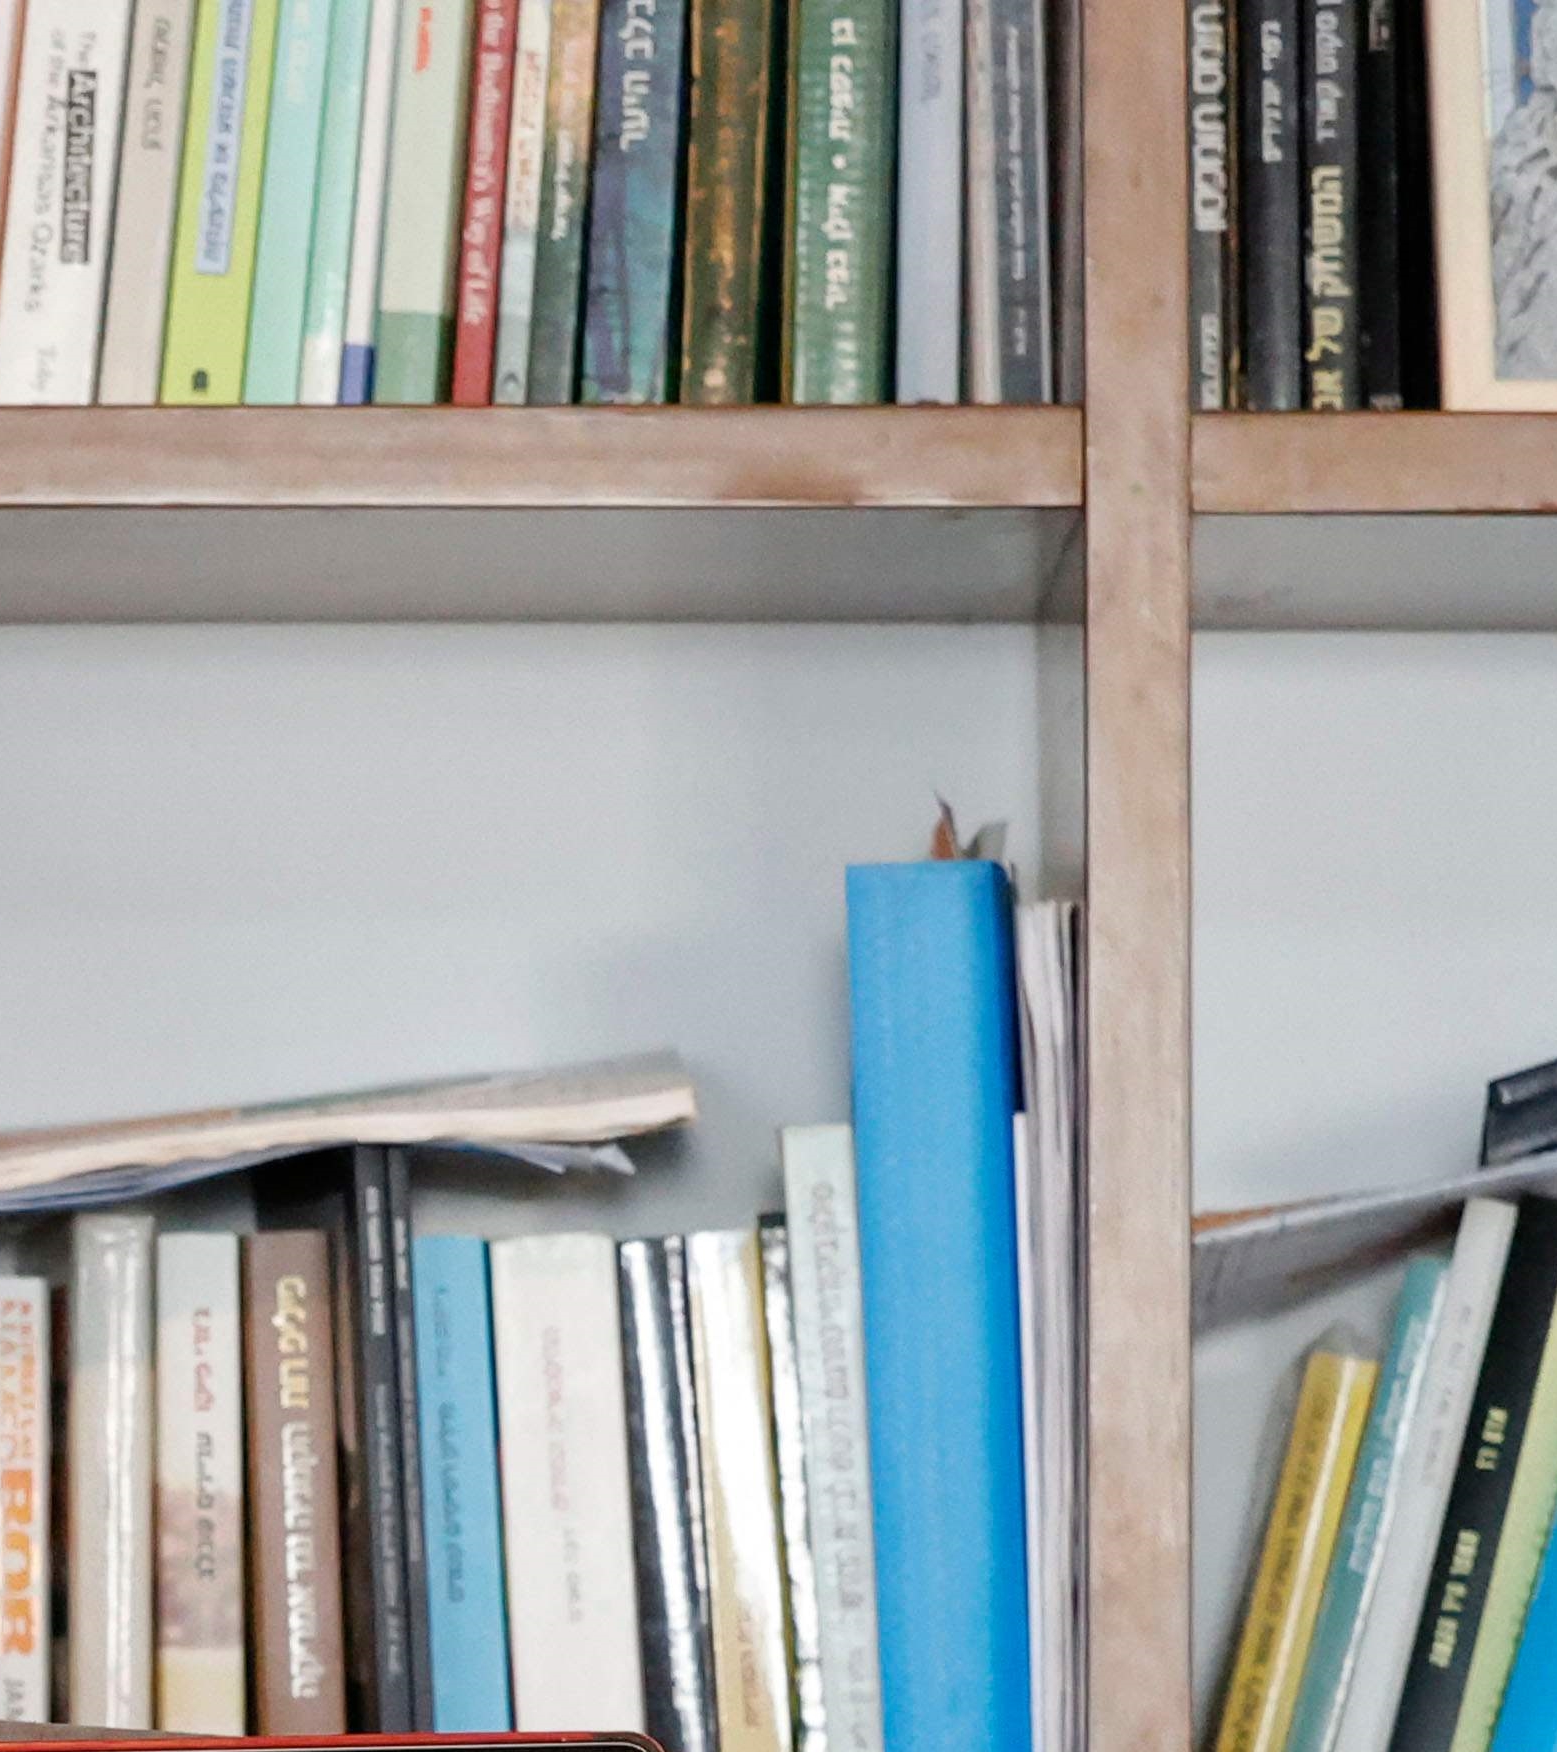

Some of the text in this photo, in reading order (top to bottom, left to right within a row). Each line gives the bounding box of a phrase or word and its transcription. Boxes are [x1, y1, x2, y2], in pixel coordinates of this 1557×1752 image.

[59, 70, 98, 265] Architecture
[822, 18, 856, 310] בן כספית אילן כפיר
[24, 222, 53, 315] Ozarks
[1306, 305, 1342, 361] של
[273, 1274, 310, 1410] פיליפ רות
[286, 1584, 322, 1698] אמריקה
